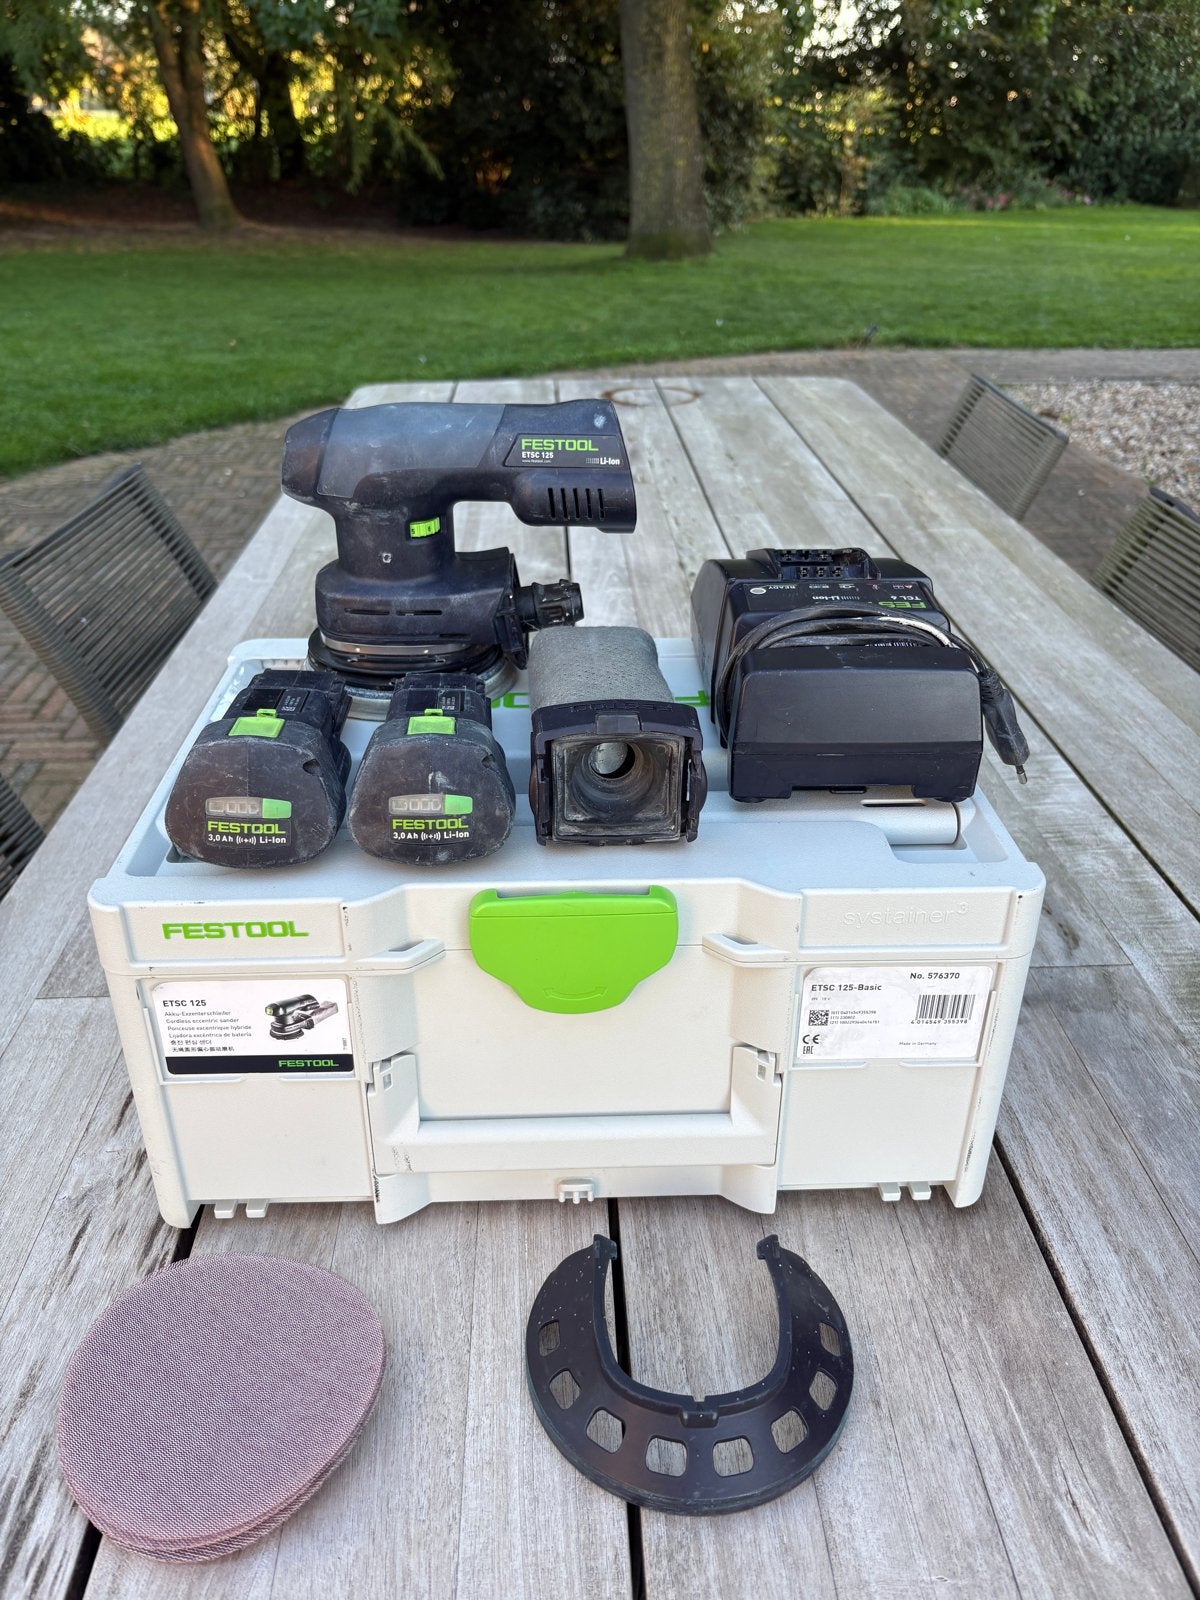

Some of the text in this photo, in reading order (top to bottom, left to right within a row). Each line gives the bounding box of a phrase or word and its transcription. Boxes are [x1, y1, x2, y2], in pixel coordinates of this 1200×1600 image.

[521, 438, 599, 451] FESTOOL
[521, 451, 554, 459] ETSC 125
[600, 457, 620, 465] Li-Ion
[207, 820, 286, 834] FESTOOL
[392, 818, 469, 830] FESTOOL
[208, 833, 287, 844] 3,0 Ah Li-Ion
[393, 832, 406, 840] 3,0
[443, 831, 470, 839] Li-Ion
[162, 921, 309, 940] FESTOOL
[909, 972, 960, 980] No. 576370
[811, 983, 882, 992] ETSC 125-Basic
[162, 999, 207, 1008] ETSC 125
[278, 1059, 340, 1068] FESTOOL
